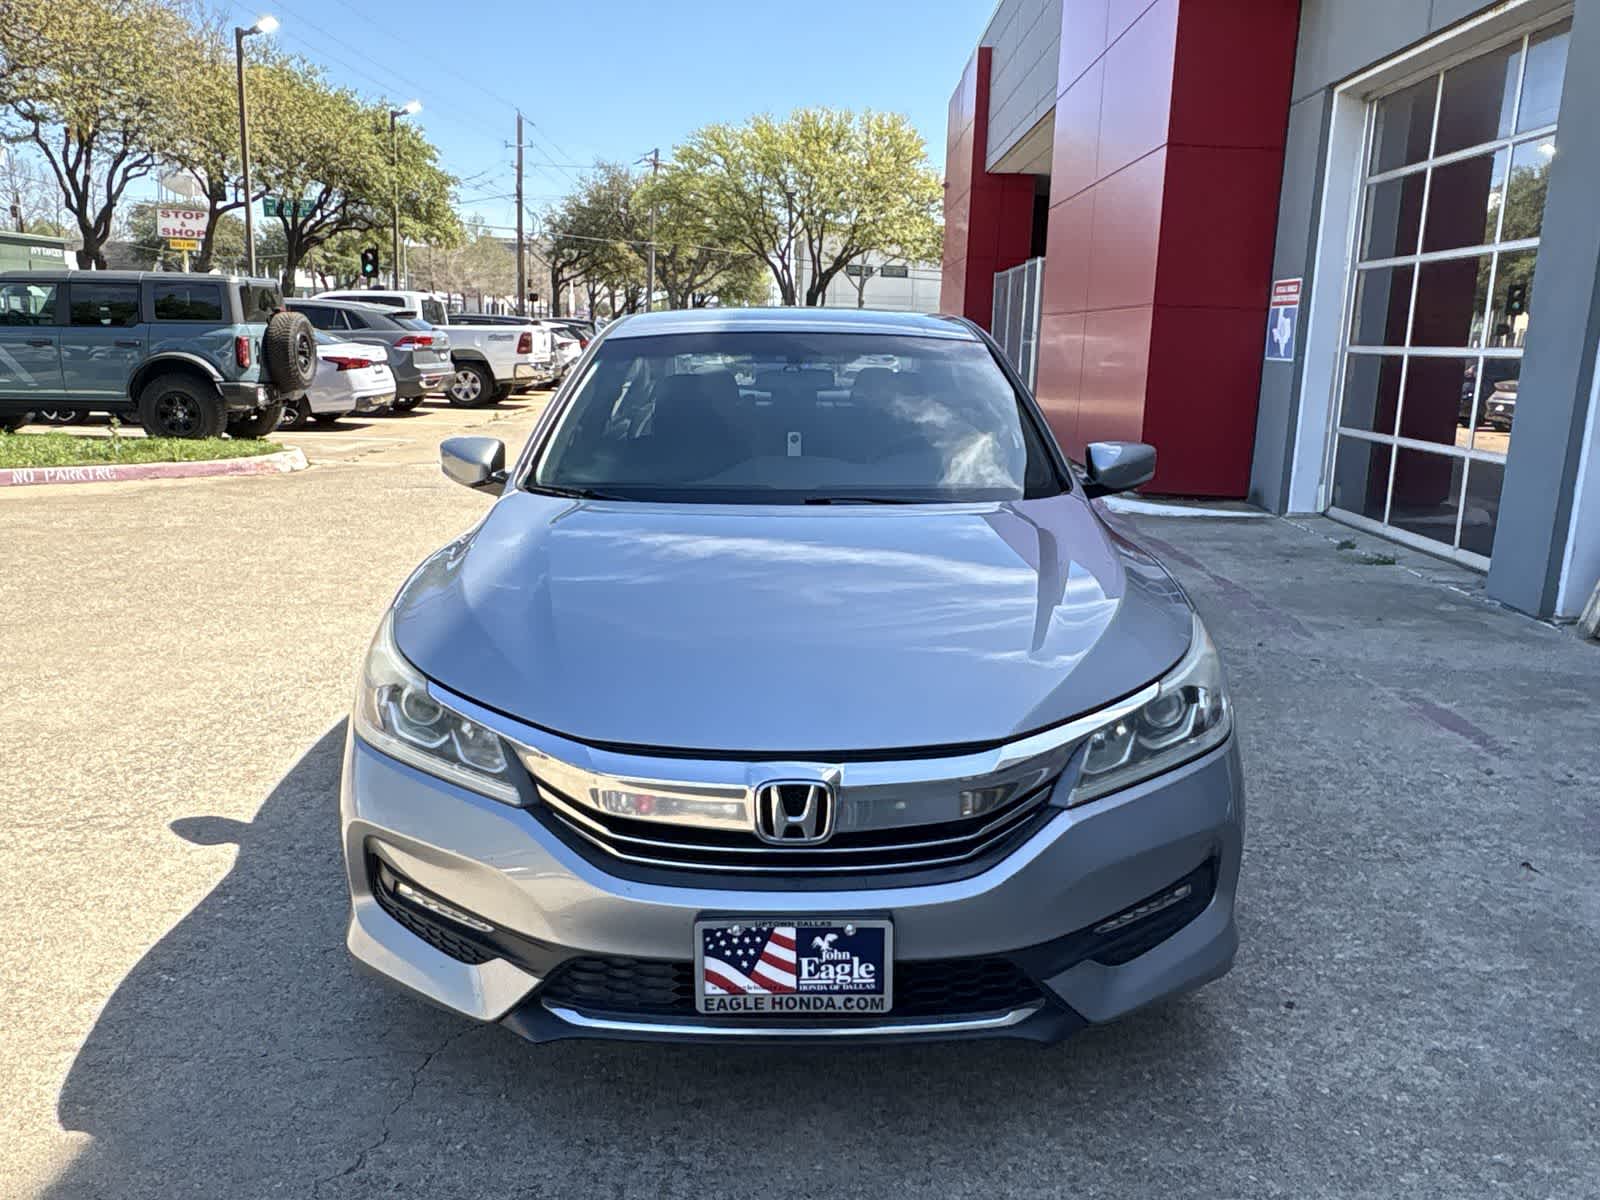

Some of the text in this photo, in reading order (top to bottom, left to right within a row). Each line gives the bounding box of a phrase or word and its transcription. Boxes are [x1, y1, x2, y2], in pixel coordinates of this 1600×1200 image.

[159, 210, 206, 221] STOP
[161, 227, 206, 238] SHOP
[12, 469, 34, 484] NO
[755, 920, 833, 928] UPTOWN DALLAS
[820, 948, 851, 963] John
[799, 956, 876, 985] Eagle
[704, 997, 885, 1011] EAGLE HONDA.COM
